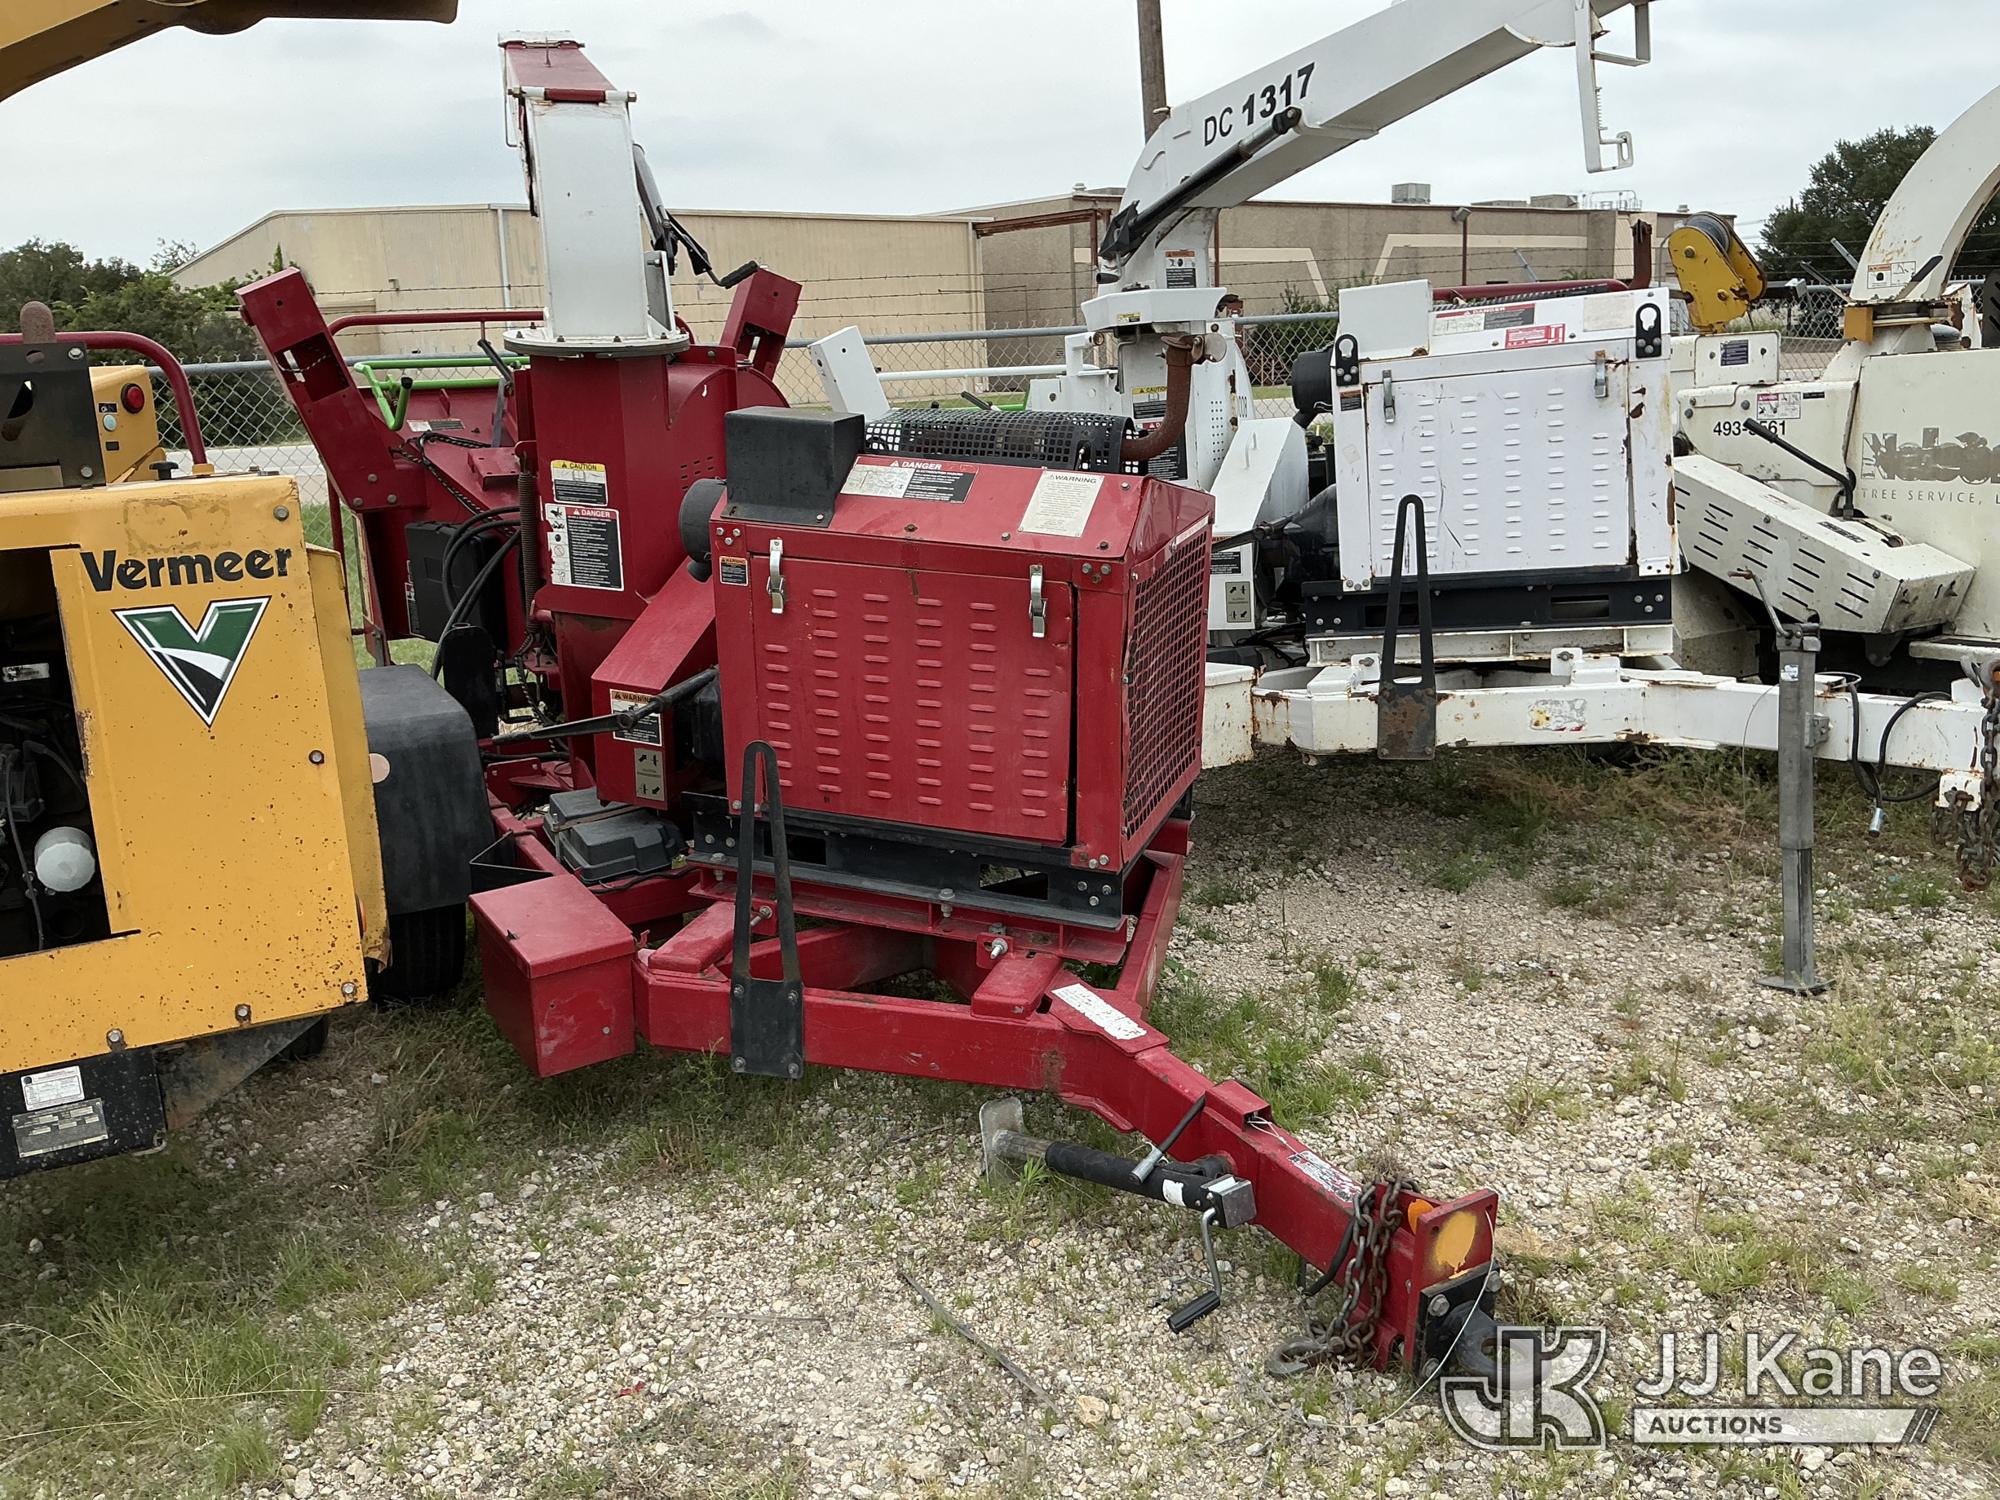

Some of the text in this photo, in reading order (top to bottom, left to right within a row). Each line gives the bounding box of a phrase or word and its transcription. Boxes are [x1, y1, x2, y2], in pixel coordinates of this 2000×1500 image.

[1204, 62, 1316, 147] DC 1317
[1713, 420, 1786, 436] 493-61
[569, 463, 597, 471] CAUTION
[901, 461, 942, 471] DANGER
[1055, 474, 1097, 484] WARNING
[1861, 488, 1897, 500] TREE
[1908, 490, 1982, 505] SERVICE,
[581, 509, 611, 518] DANGER
[80, 548, 292, 592] Vermeer
[621, 692, 649, 702] WARNIN
